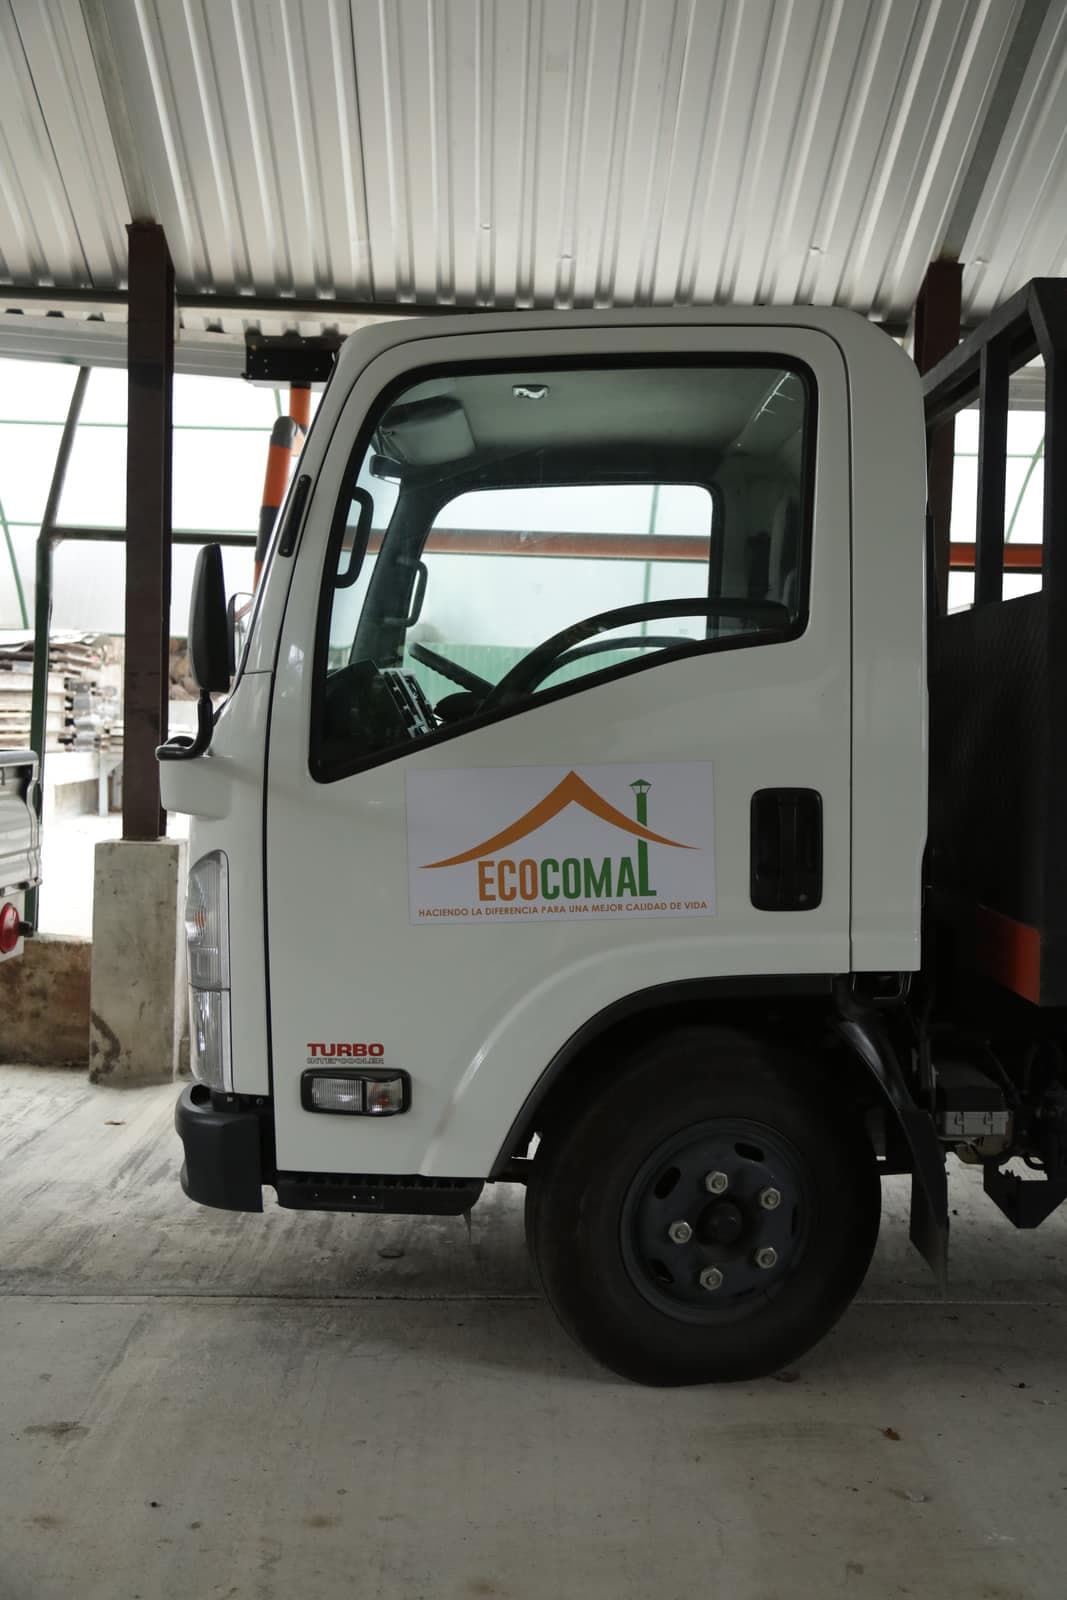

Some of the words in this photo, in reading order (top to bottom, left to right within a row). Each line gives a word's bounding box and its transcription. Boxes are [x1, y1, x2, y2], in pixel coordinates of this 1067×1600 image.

[478, 839, 657, 901] ECOCOMAL
[418, 907, 469, 917] HACIENDO
[471, 906, 483, 916] LA
[485, 905, 538, 916] DIFERENCIA
[541, 905, 566, 914] PARA
[569, 904, 589, 913] UNA
[591, 903, 623, 913] MEJOR
[625, 902, 667, 912] CALIDAD
[669, 901, 682, 910] DE
[684, 900, 707, 910] VIDA
[307, 1043, 385, 1057] TURBO
